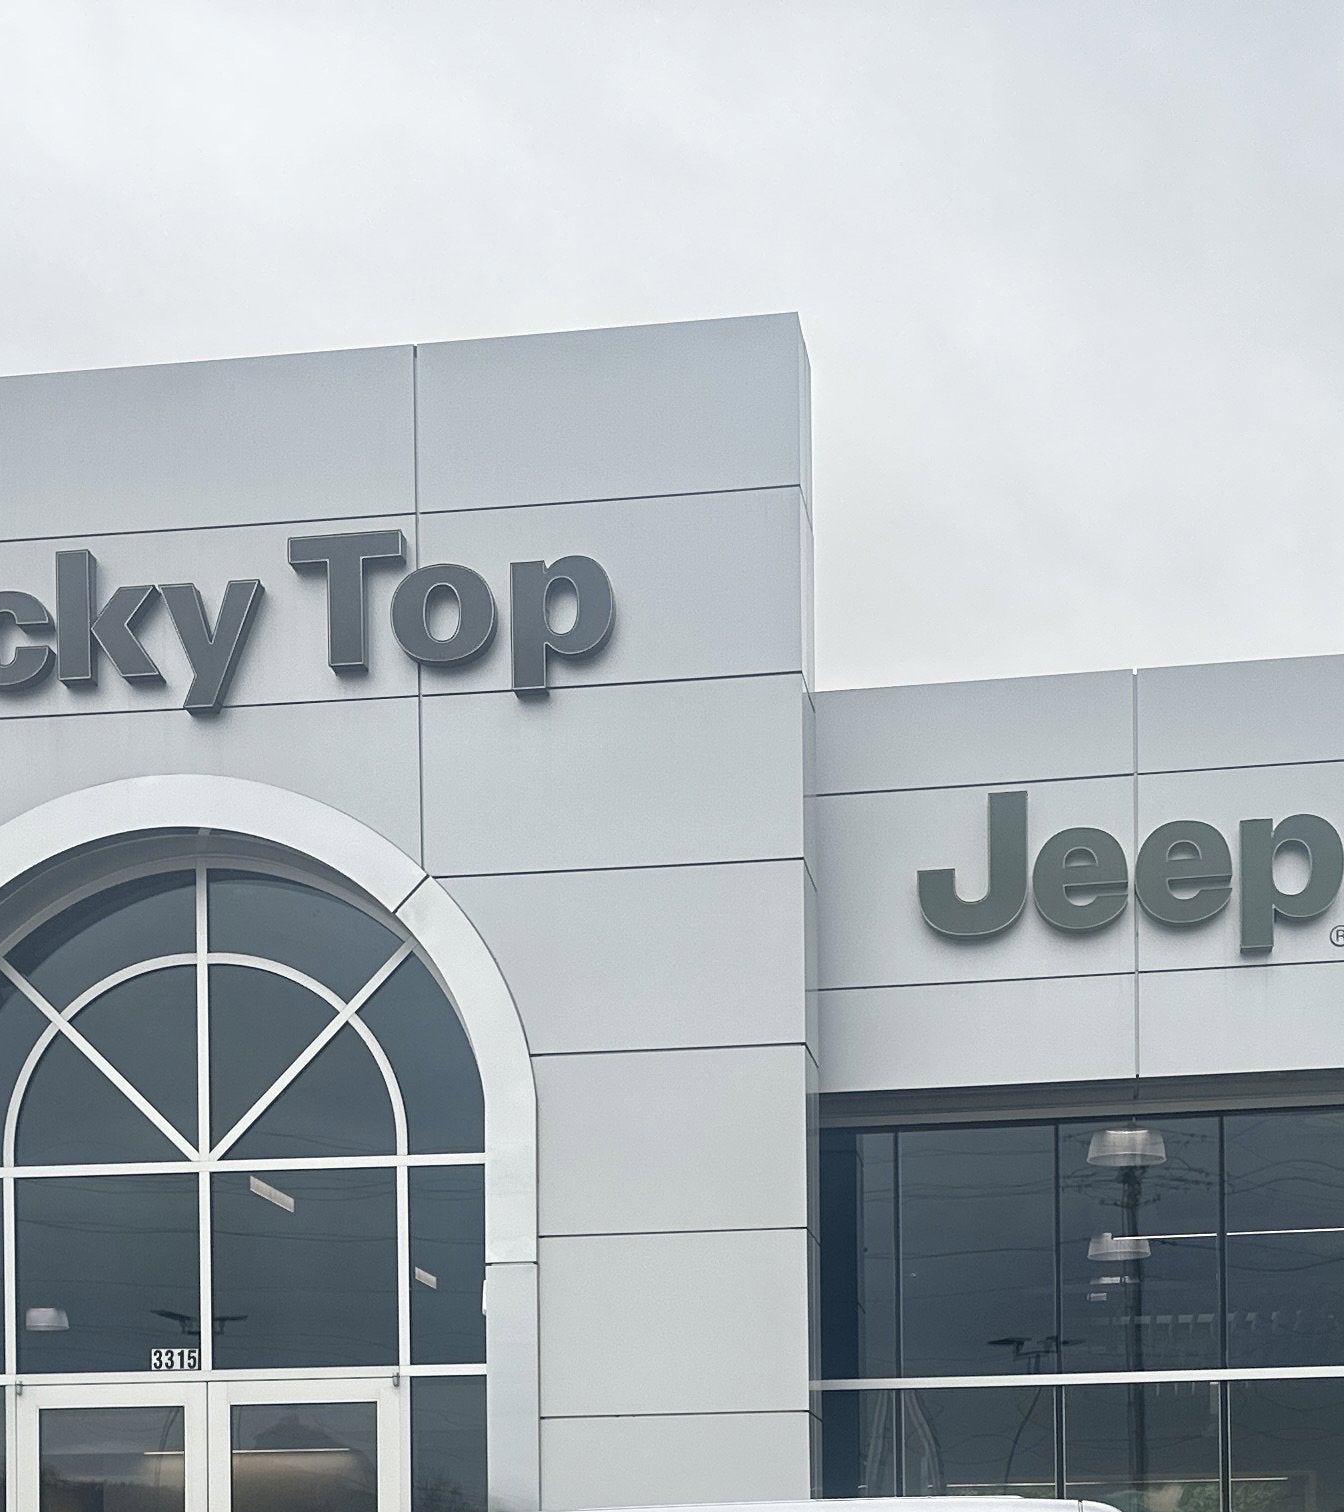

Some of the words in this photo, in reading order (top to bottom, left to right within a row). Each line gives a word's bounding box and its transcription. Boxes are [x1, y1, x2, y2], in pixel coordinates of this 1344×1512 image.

[288, 530, 616, 701] Top
[917, 790, 1344, 955] Jeep
[153, 1349, 197, 1369] 3315
